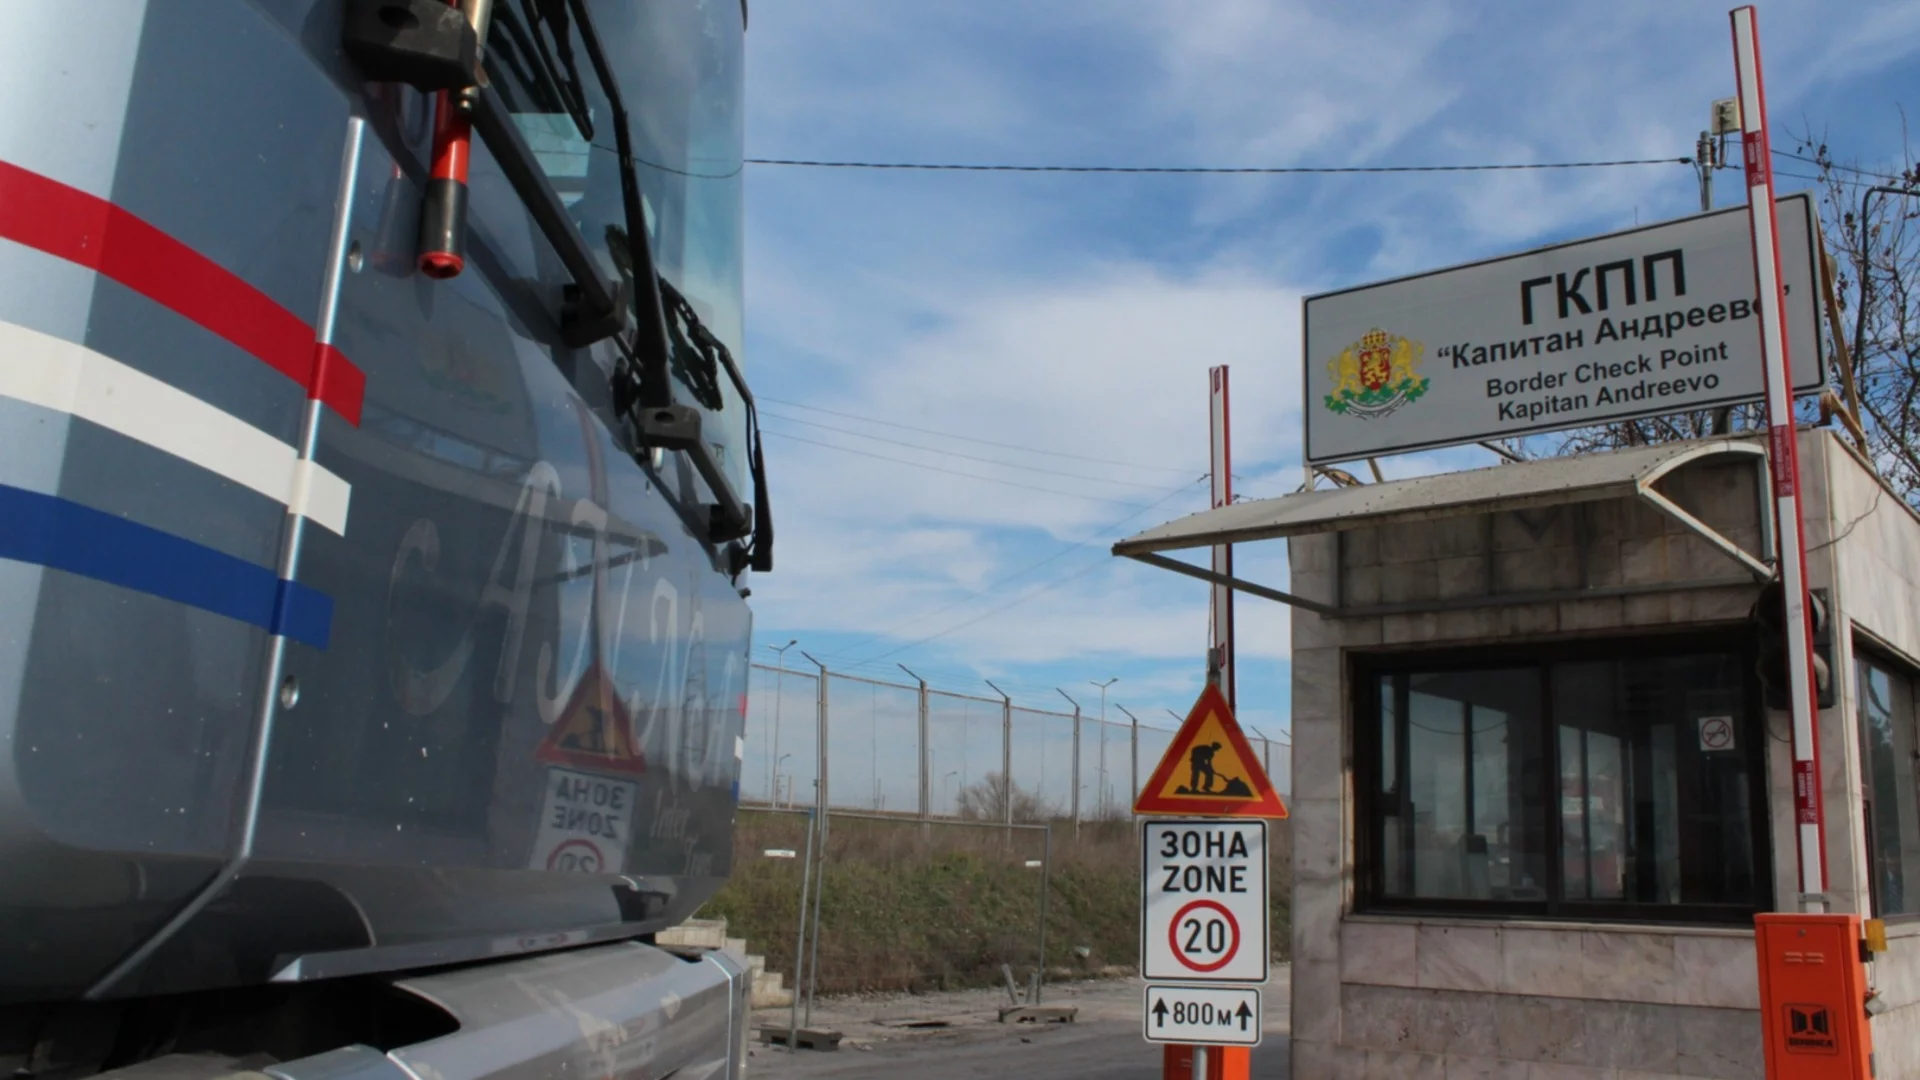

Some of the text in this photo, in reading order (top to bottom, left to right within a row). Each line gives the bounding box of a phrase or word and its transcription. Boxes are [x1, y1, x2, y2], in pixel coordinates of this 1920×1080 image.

[1521, 248, 1686, 325] ГКПП
[1487, 341, 1729, 398] Border Check Point
[1498, 373, 1720, 421] Kapitan Andreevo
[1160, 831, 1249, 859] ЗОНА
[1162, 865, 1247, 893] ZONE
[1183, 918, 1226, 954] 20
